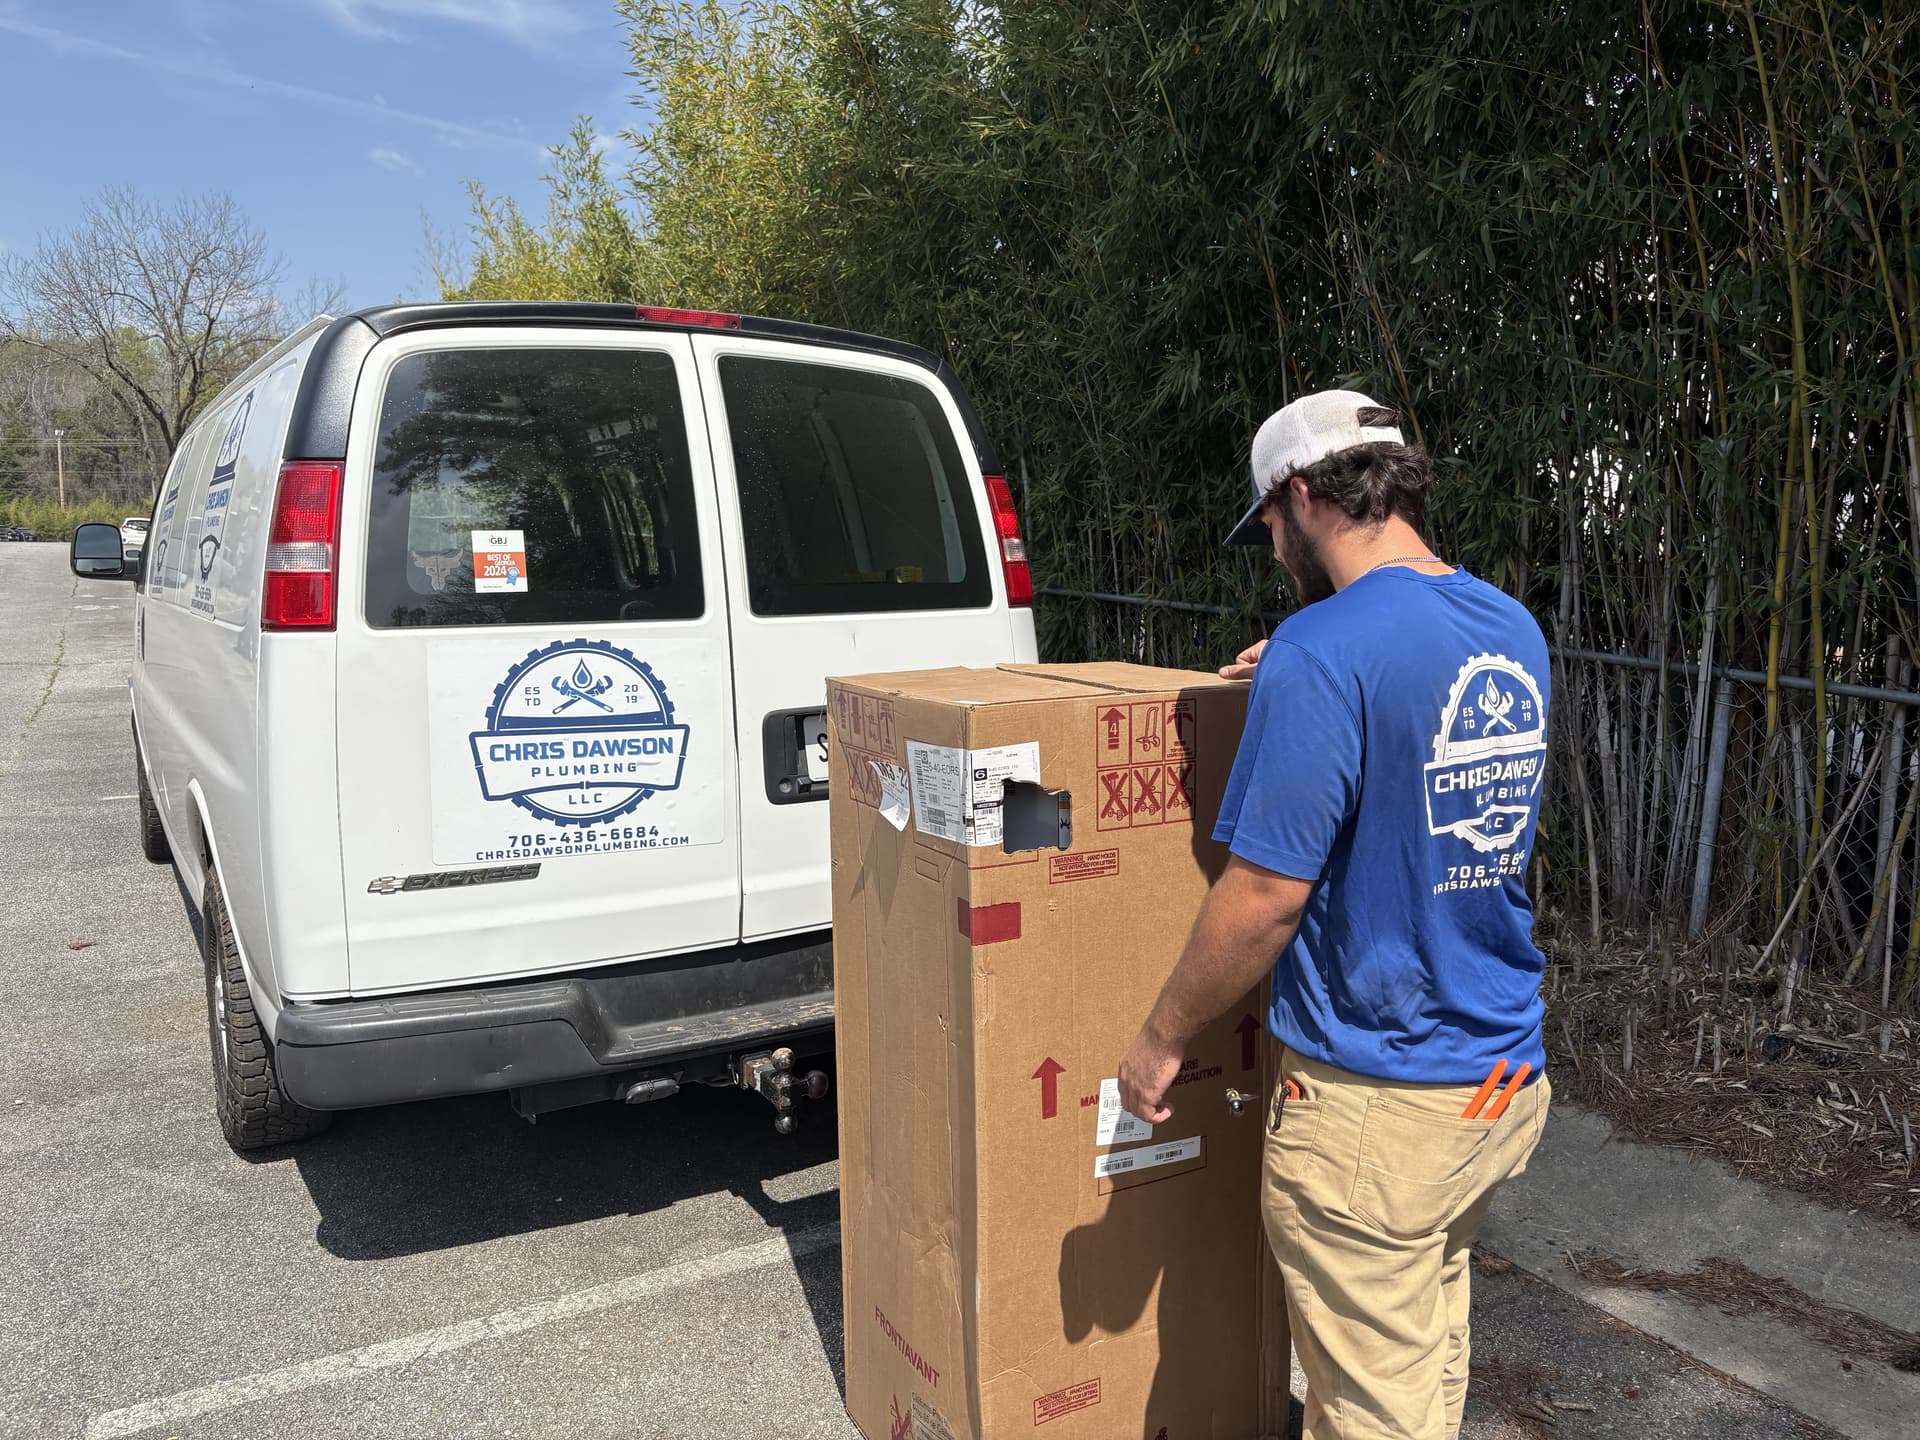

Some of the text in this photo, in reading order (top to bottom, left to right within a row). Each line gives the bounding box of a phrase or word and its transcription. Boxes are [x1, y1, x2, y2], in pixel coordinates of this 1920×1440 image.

[490, 537, 508, 545] GBJ
[503, 553, 512, 561] OF
[483, 565, 507, 577] 2024
[524, 686, 541, 695] ES
[624, 684, 639, 693] 20
[524, 697, 541, 706] TD
[625, 695, 638, 704] 19
[1521, 699, 1531, 710] 20
[1462, 706, 1474, 718] ES
[1522, 711, 1532, 722] 19
[1109, 722, 1118, 736] 4
[1464, 719, 1476, 730] TD
[489, 736, 674, 763] CHRIS DAWSON
[531, 762, 638, 778] PLUMBING
[975, 769, 987, 780] 6
[1434, 764, 1490, 794] CHRIS
[568, 792, 604, 805] LLC
[508, 826, 660, 848] 706-436-6684
[476, 836, 690, 861] CHRISDAWSONPLUMBING.COM
[405, 864, 539, 889] EXPRESS
[1179, 1058, 1199, 1073] ARE
